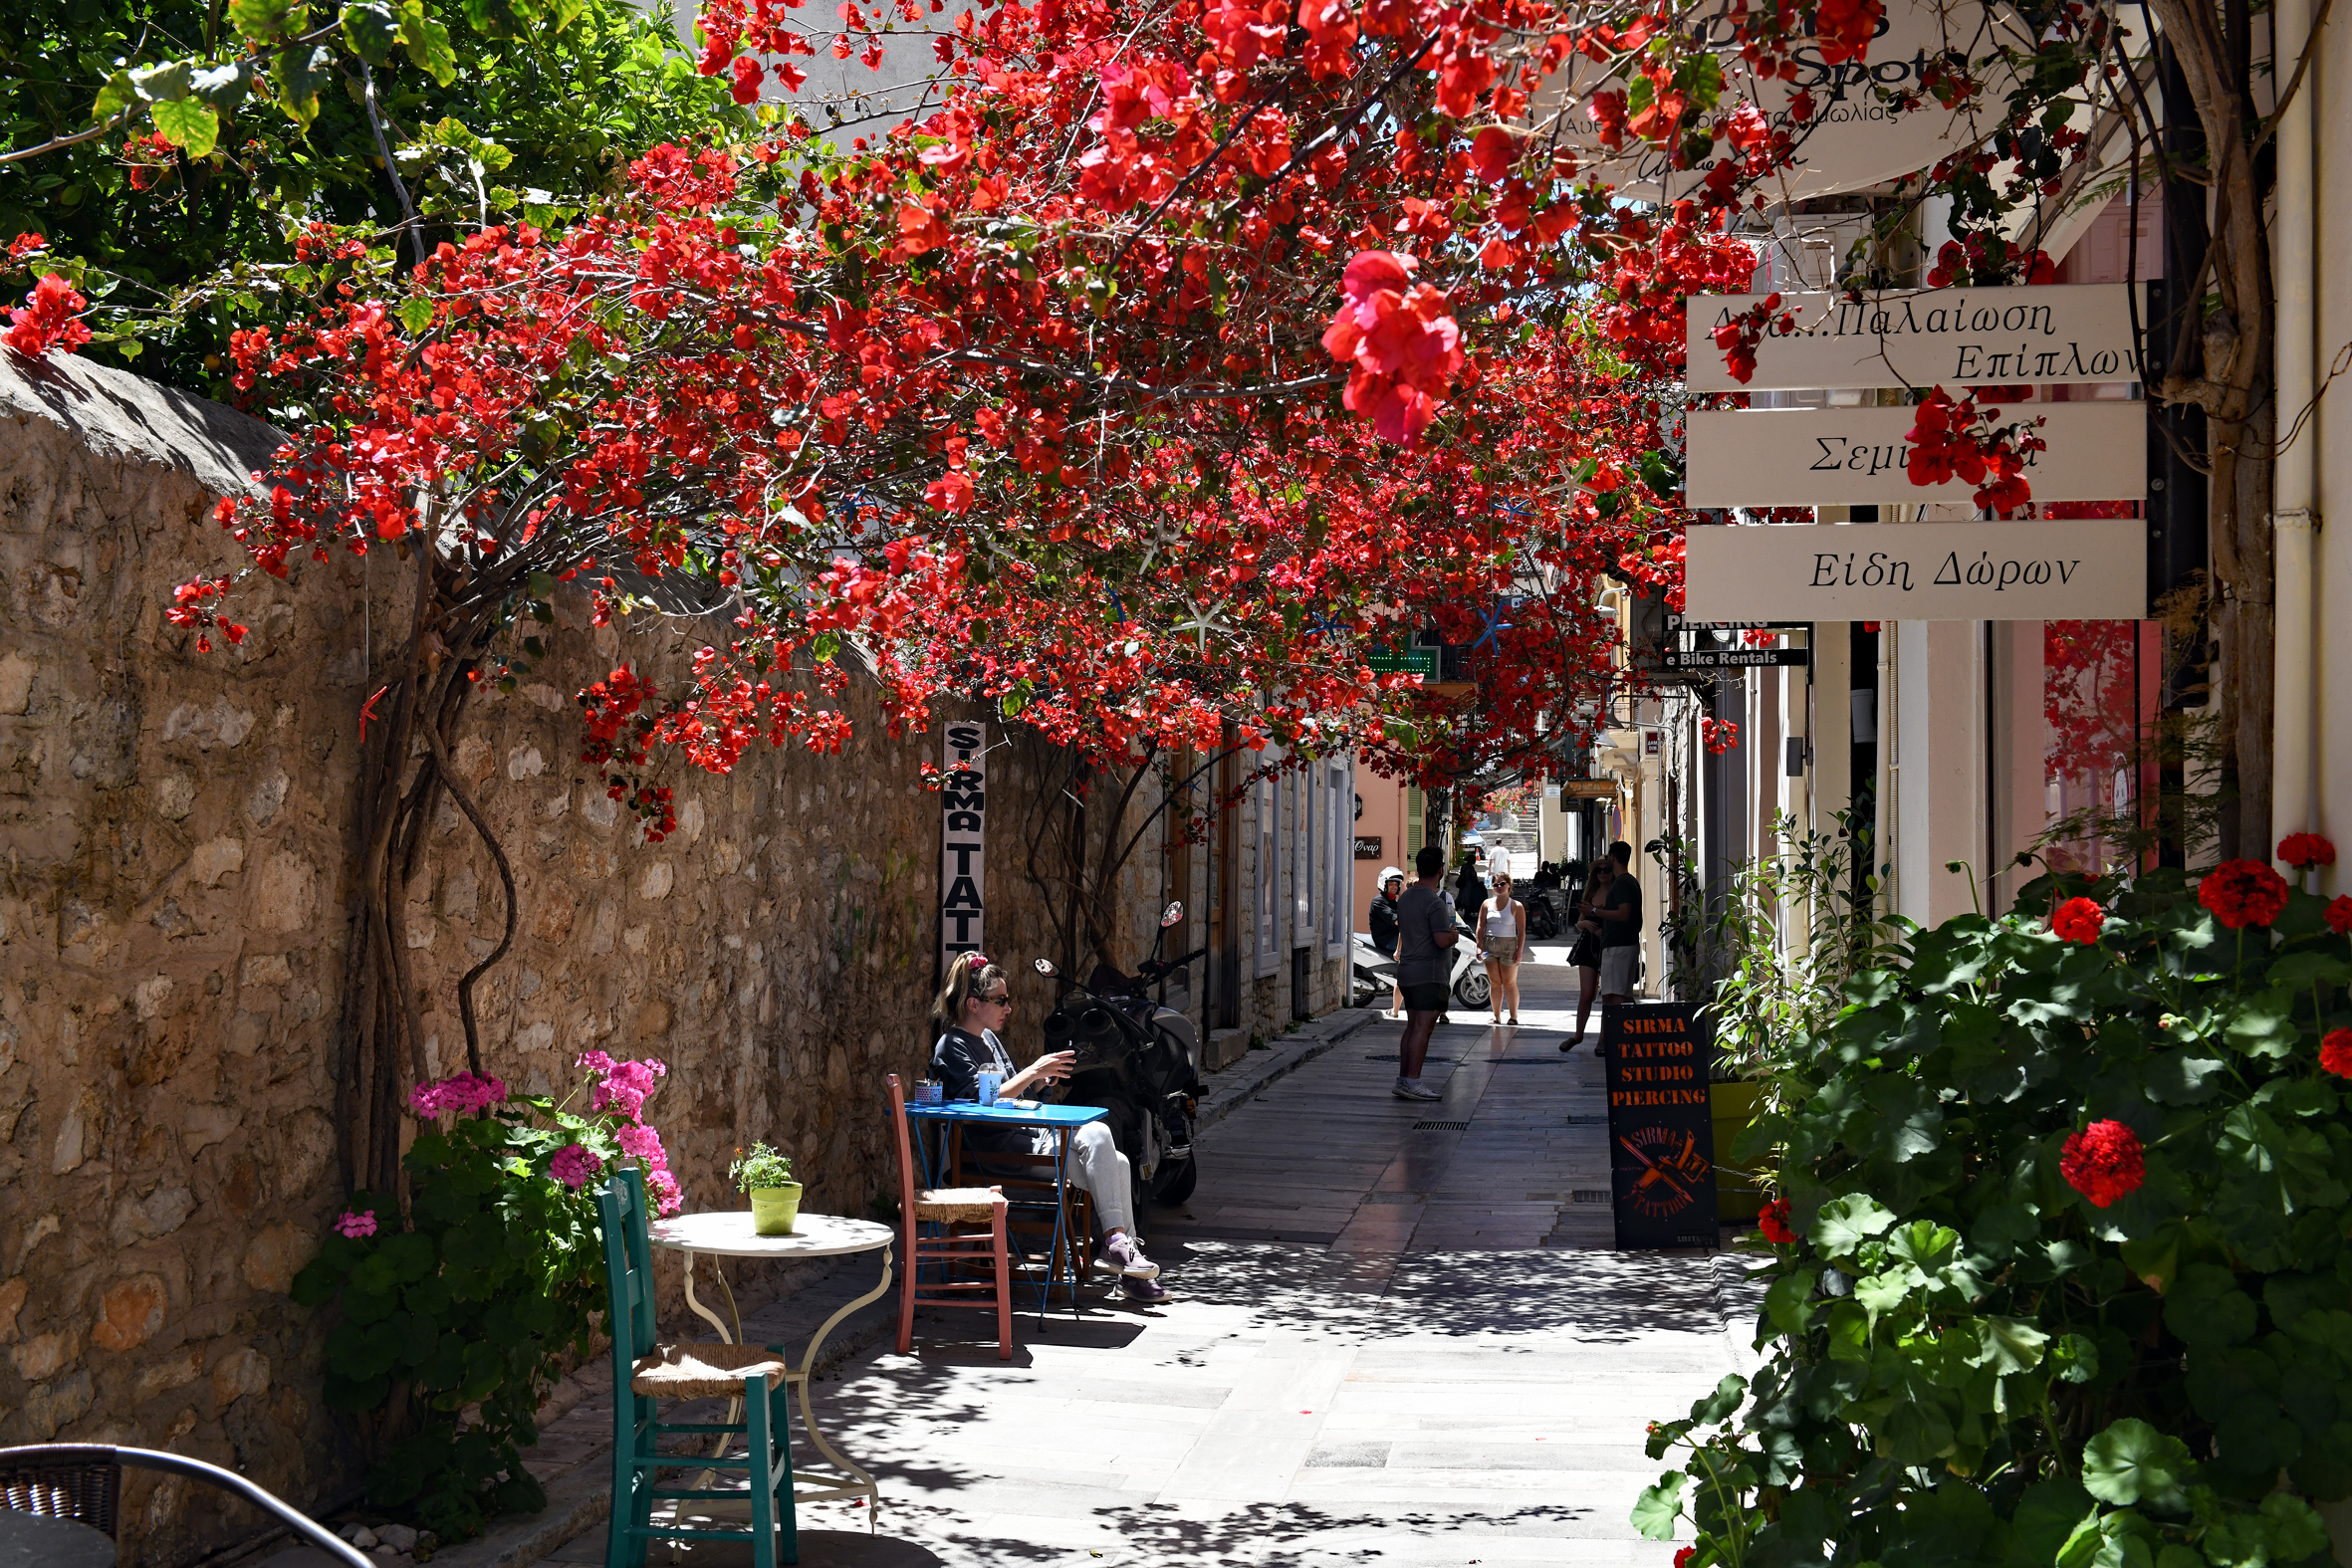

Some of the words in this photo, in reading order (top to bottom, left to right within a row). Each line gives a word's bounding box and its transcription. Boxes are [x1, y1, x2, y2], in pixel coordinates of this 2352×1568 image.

[1787, 46, 1932, 102] Spot
[1952, 342, 2147, 380] Επίπλων
[1809, 553, 1914, 591] Είδη
[1934, 551, 2080, 591] Δώρων
[1666, 655, 1676, 666] e
[1680, 652, 1714, 665] Bike
[1719, 651, 1777, 664] Rentals
[943, 727, 985, 832] SIRMA
[1623, 1017, 1686, 1034] SIRMA
[1618, 1041, 1694, 1058] TATTOO
[1621, 1065, 1694, 1082] STUDIO
[1612, 1088, 1706, 1106] PIERCING
[1631, 1126, 1677, 1148] SIRMA
